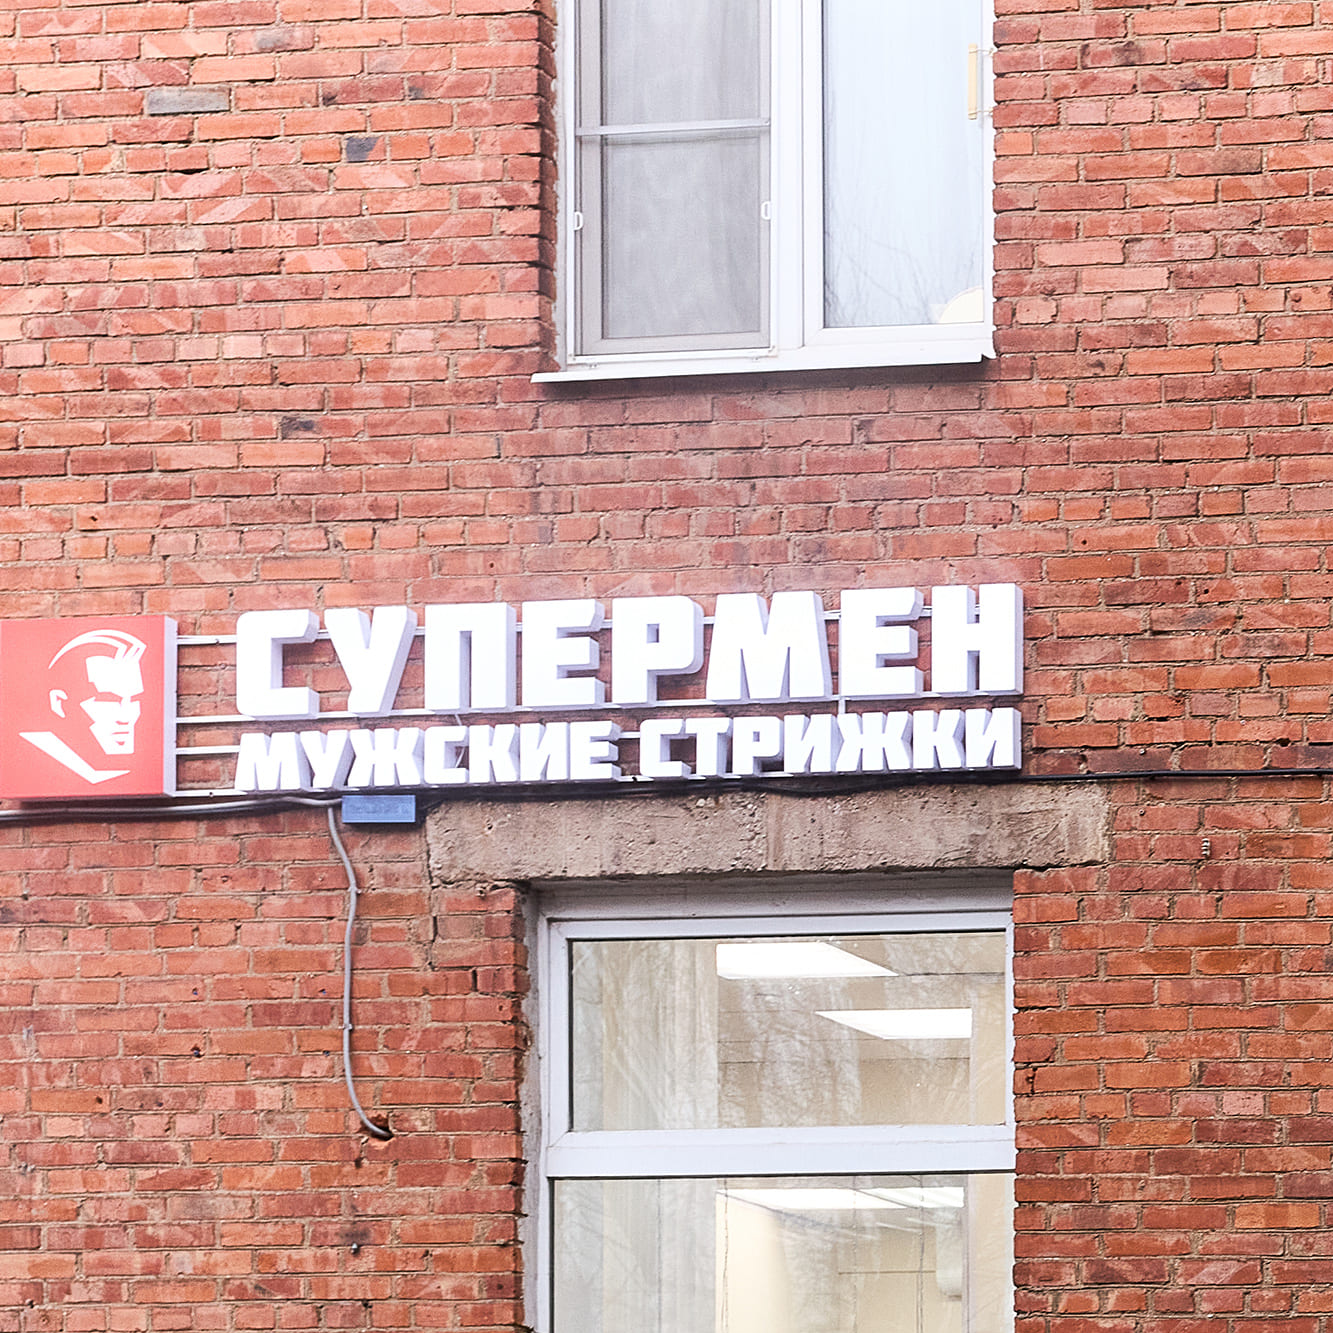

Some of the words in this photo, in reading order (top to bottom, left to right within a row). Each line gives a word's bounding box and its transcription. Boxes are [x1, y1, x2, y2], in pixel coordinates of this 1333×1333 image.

[236, 583, 1022, 718] СУПЕРМЕН
[235, 720, 620, 792] МУЖСКИЕ
[638, 707, 1021, 780] СТРИЖКИ
